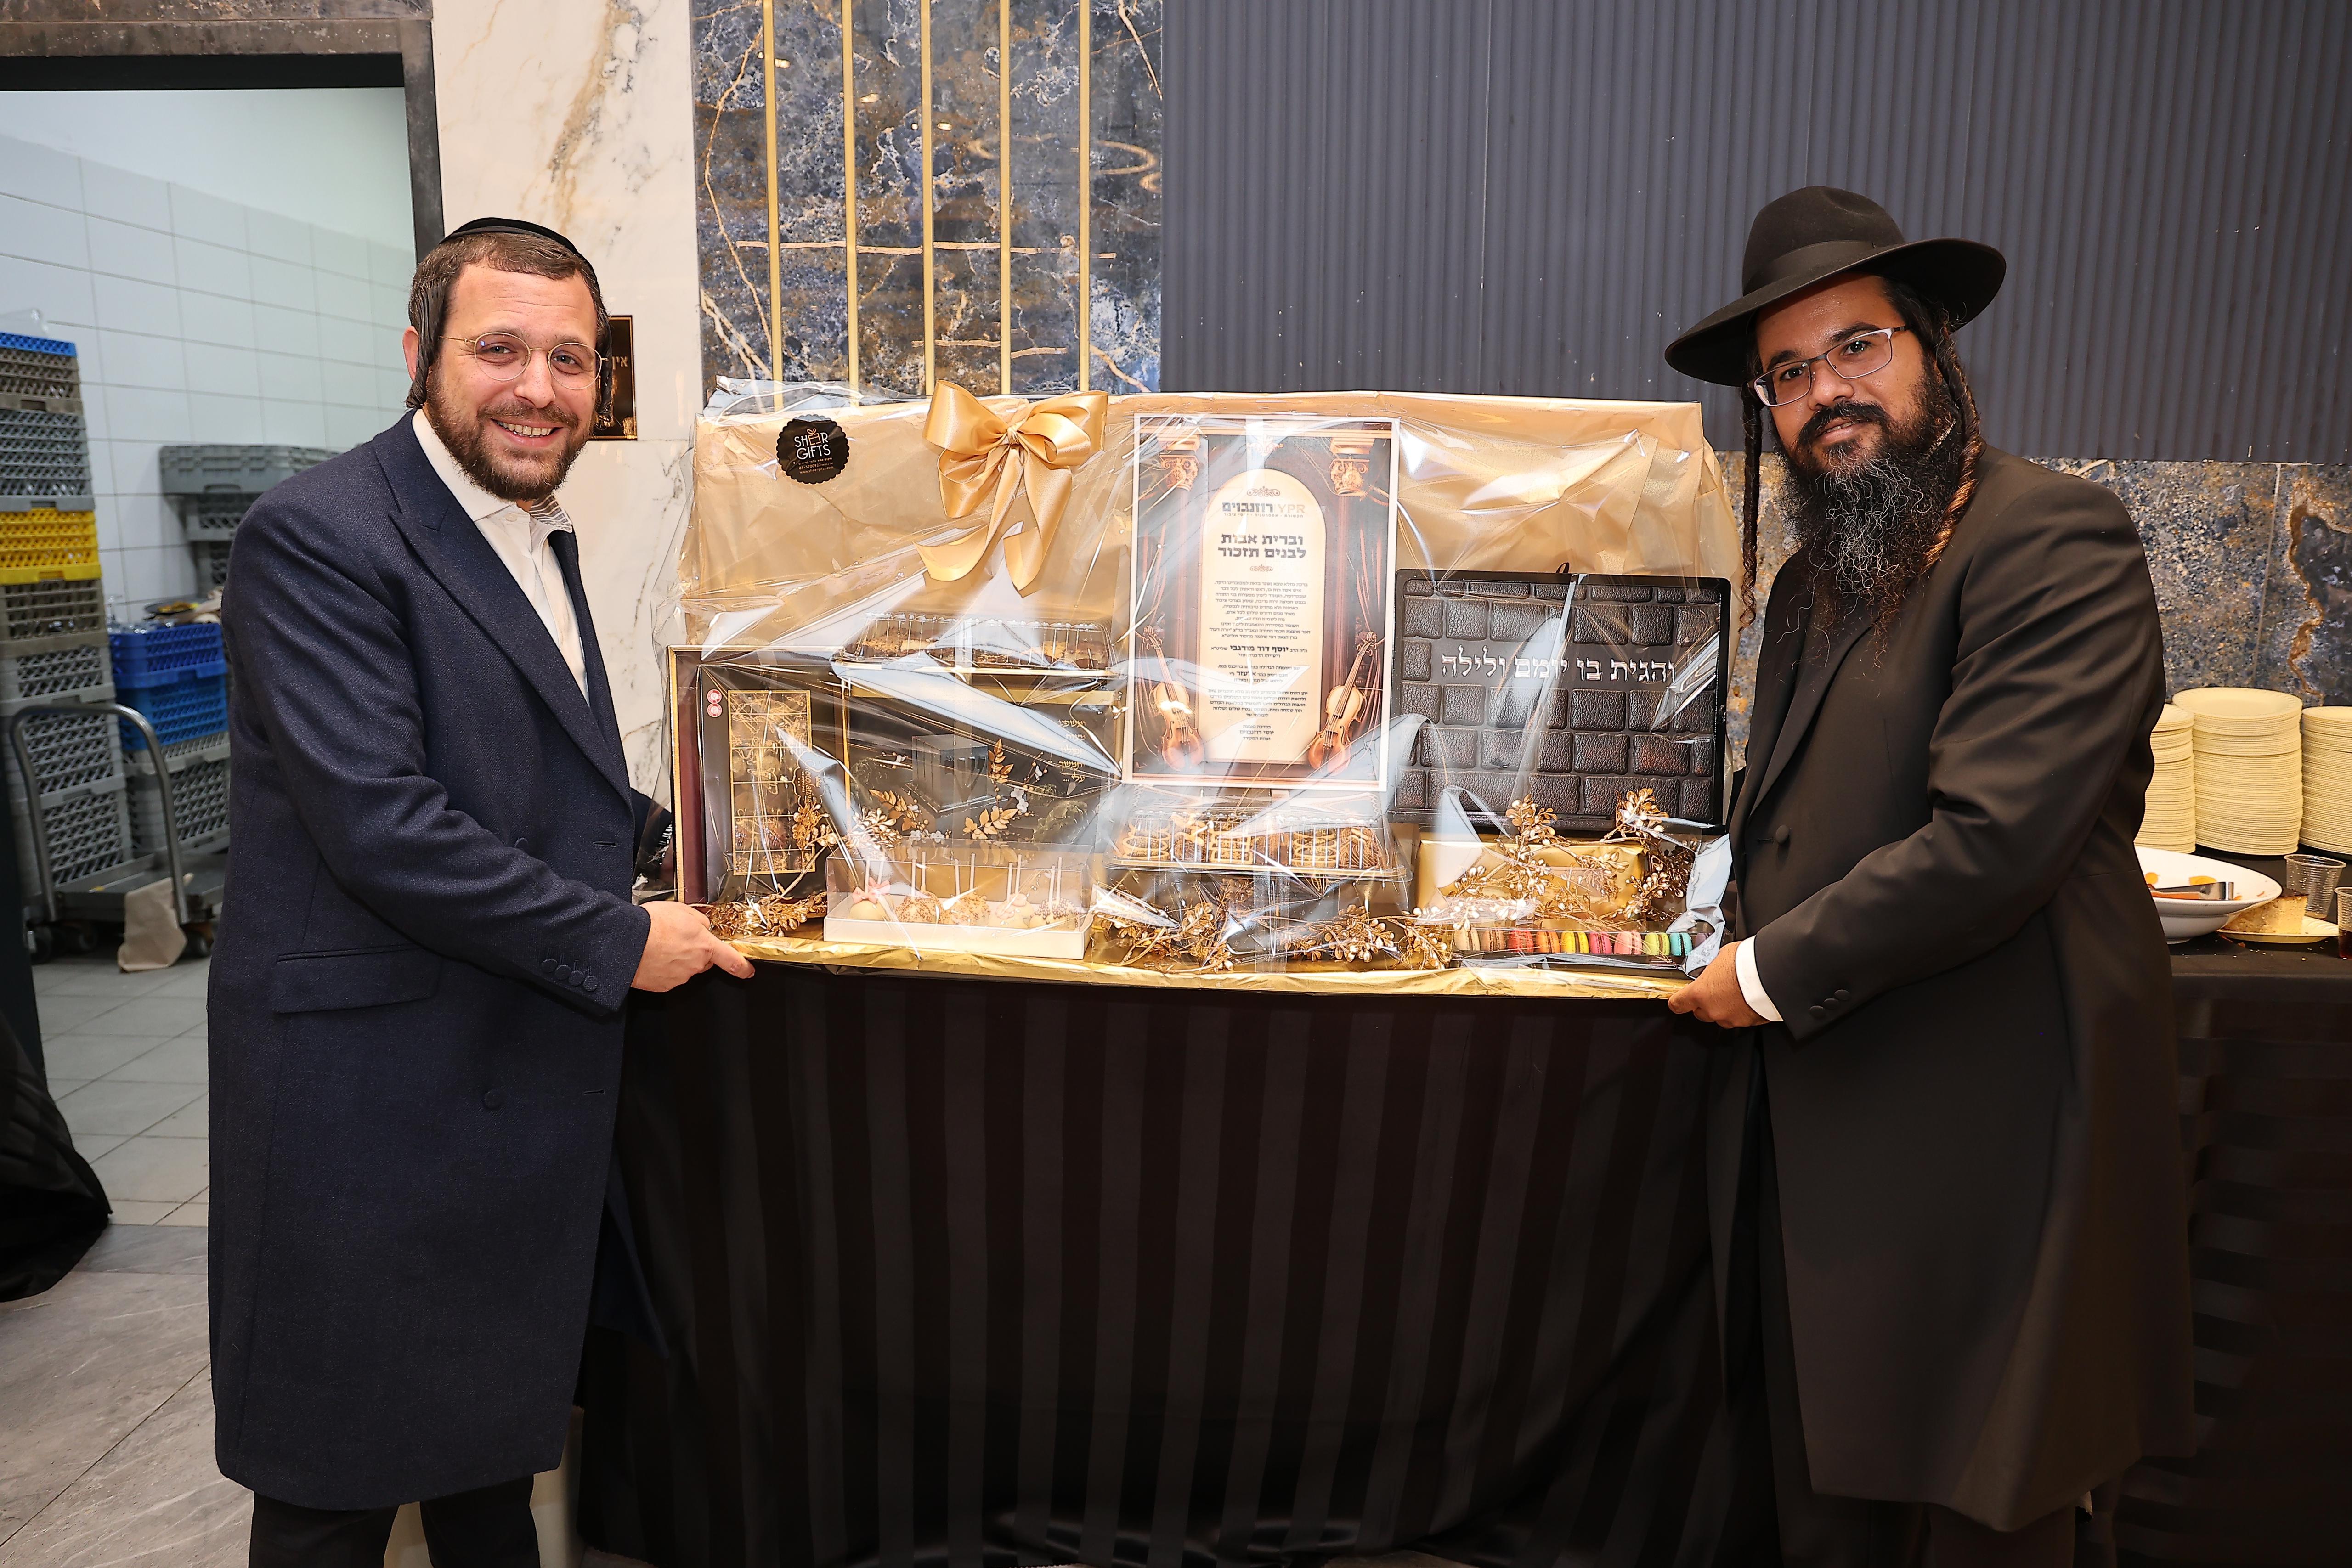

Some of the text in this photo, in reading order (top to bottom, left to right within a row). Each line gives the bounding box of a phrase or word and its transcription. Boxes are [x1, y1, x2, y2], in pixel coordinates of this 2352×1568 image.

[794, 432, 828, 447] SHEER
[796, 444, 831, 460] GIFTS
[1222, 502, 1305, 513] YPR רוזנבוים
[1221, 533, 1303, 545] וברית אבות
[1218, 547, 1306, 558] לבנים תזכור
[1441, 644, 1675, 683] והגית בו יומם ולילה
